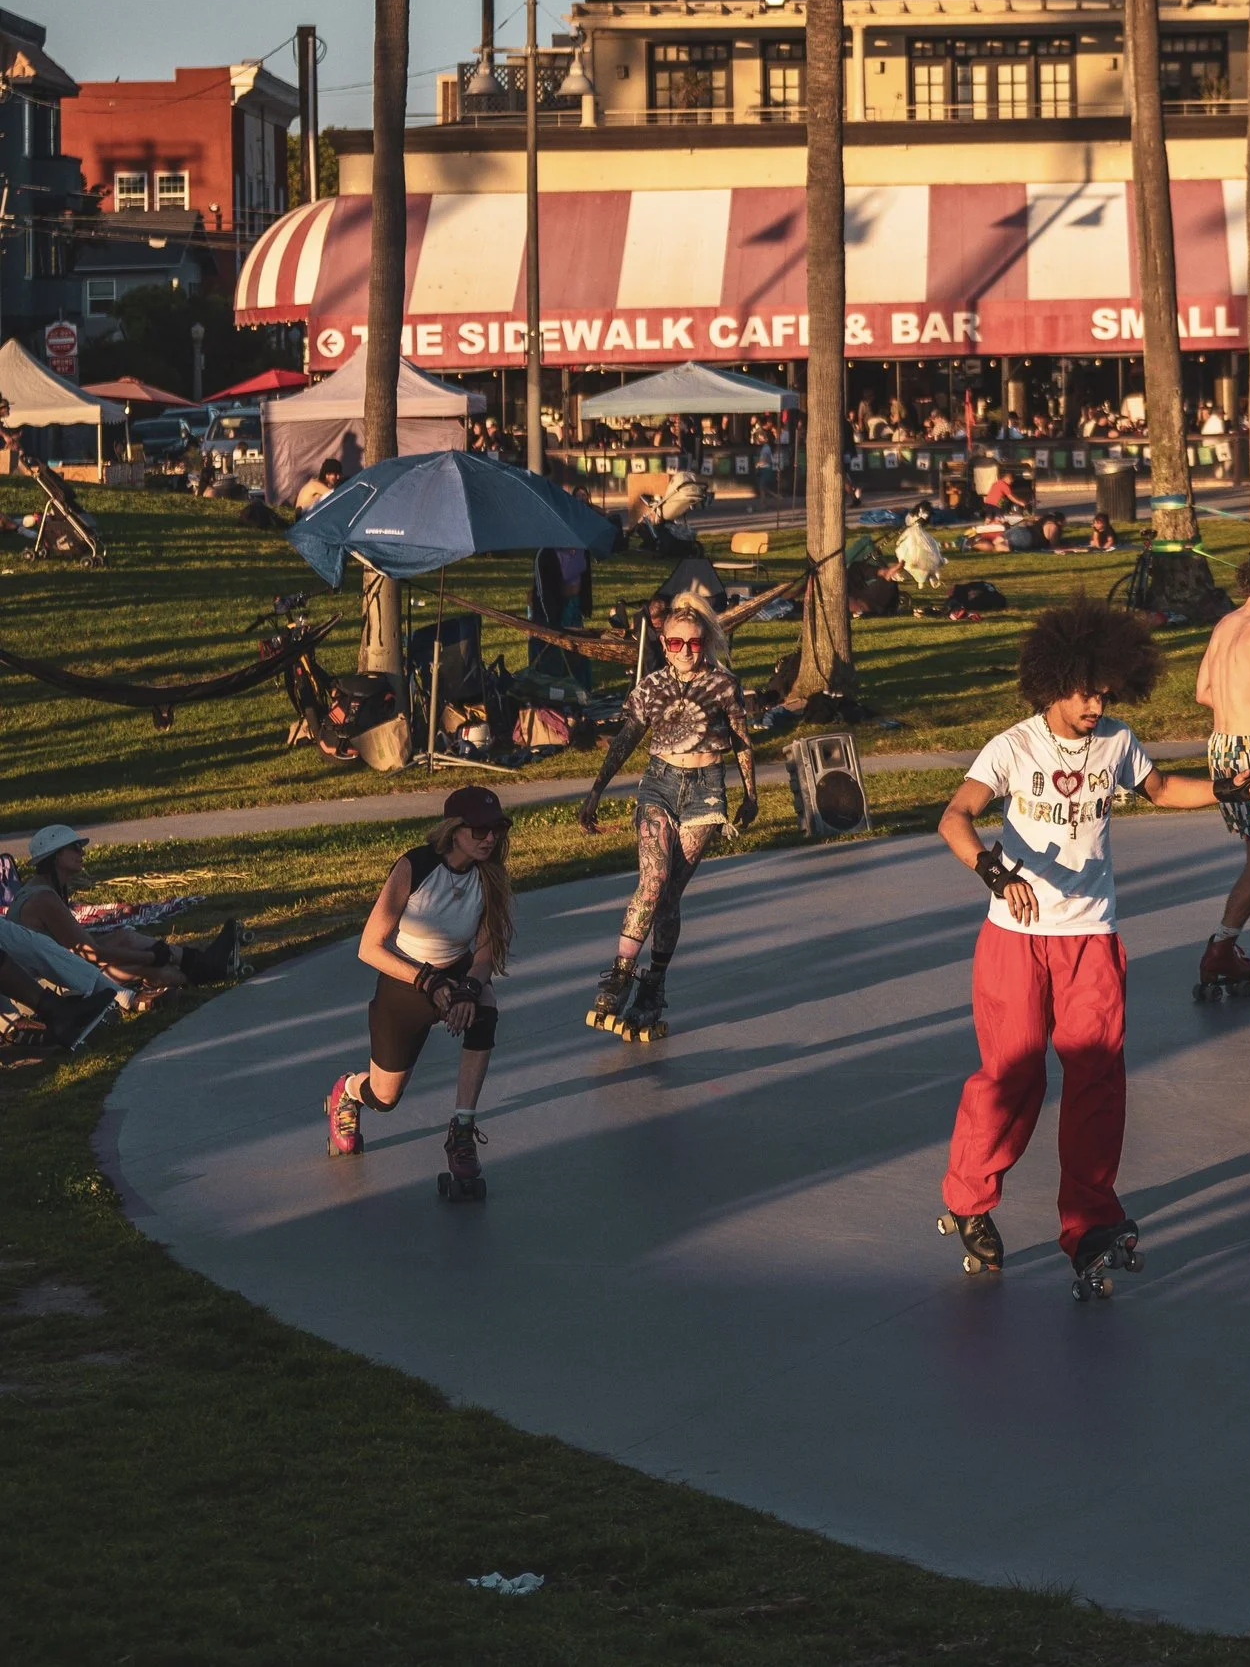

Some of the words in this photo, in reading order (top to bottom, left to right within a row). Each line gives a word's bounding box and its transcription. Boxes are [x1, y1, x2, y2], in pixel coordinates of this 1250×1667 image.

[458, 316, 695, 355] SIDEWALK
[844, 313, 874, 345] &
[891, 311, 982, 344] BAR
[1031, 771, 1045, 797] I
[1087, 764, 1117, 793] M
